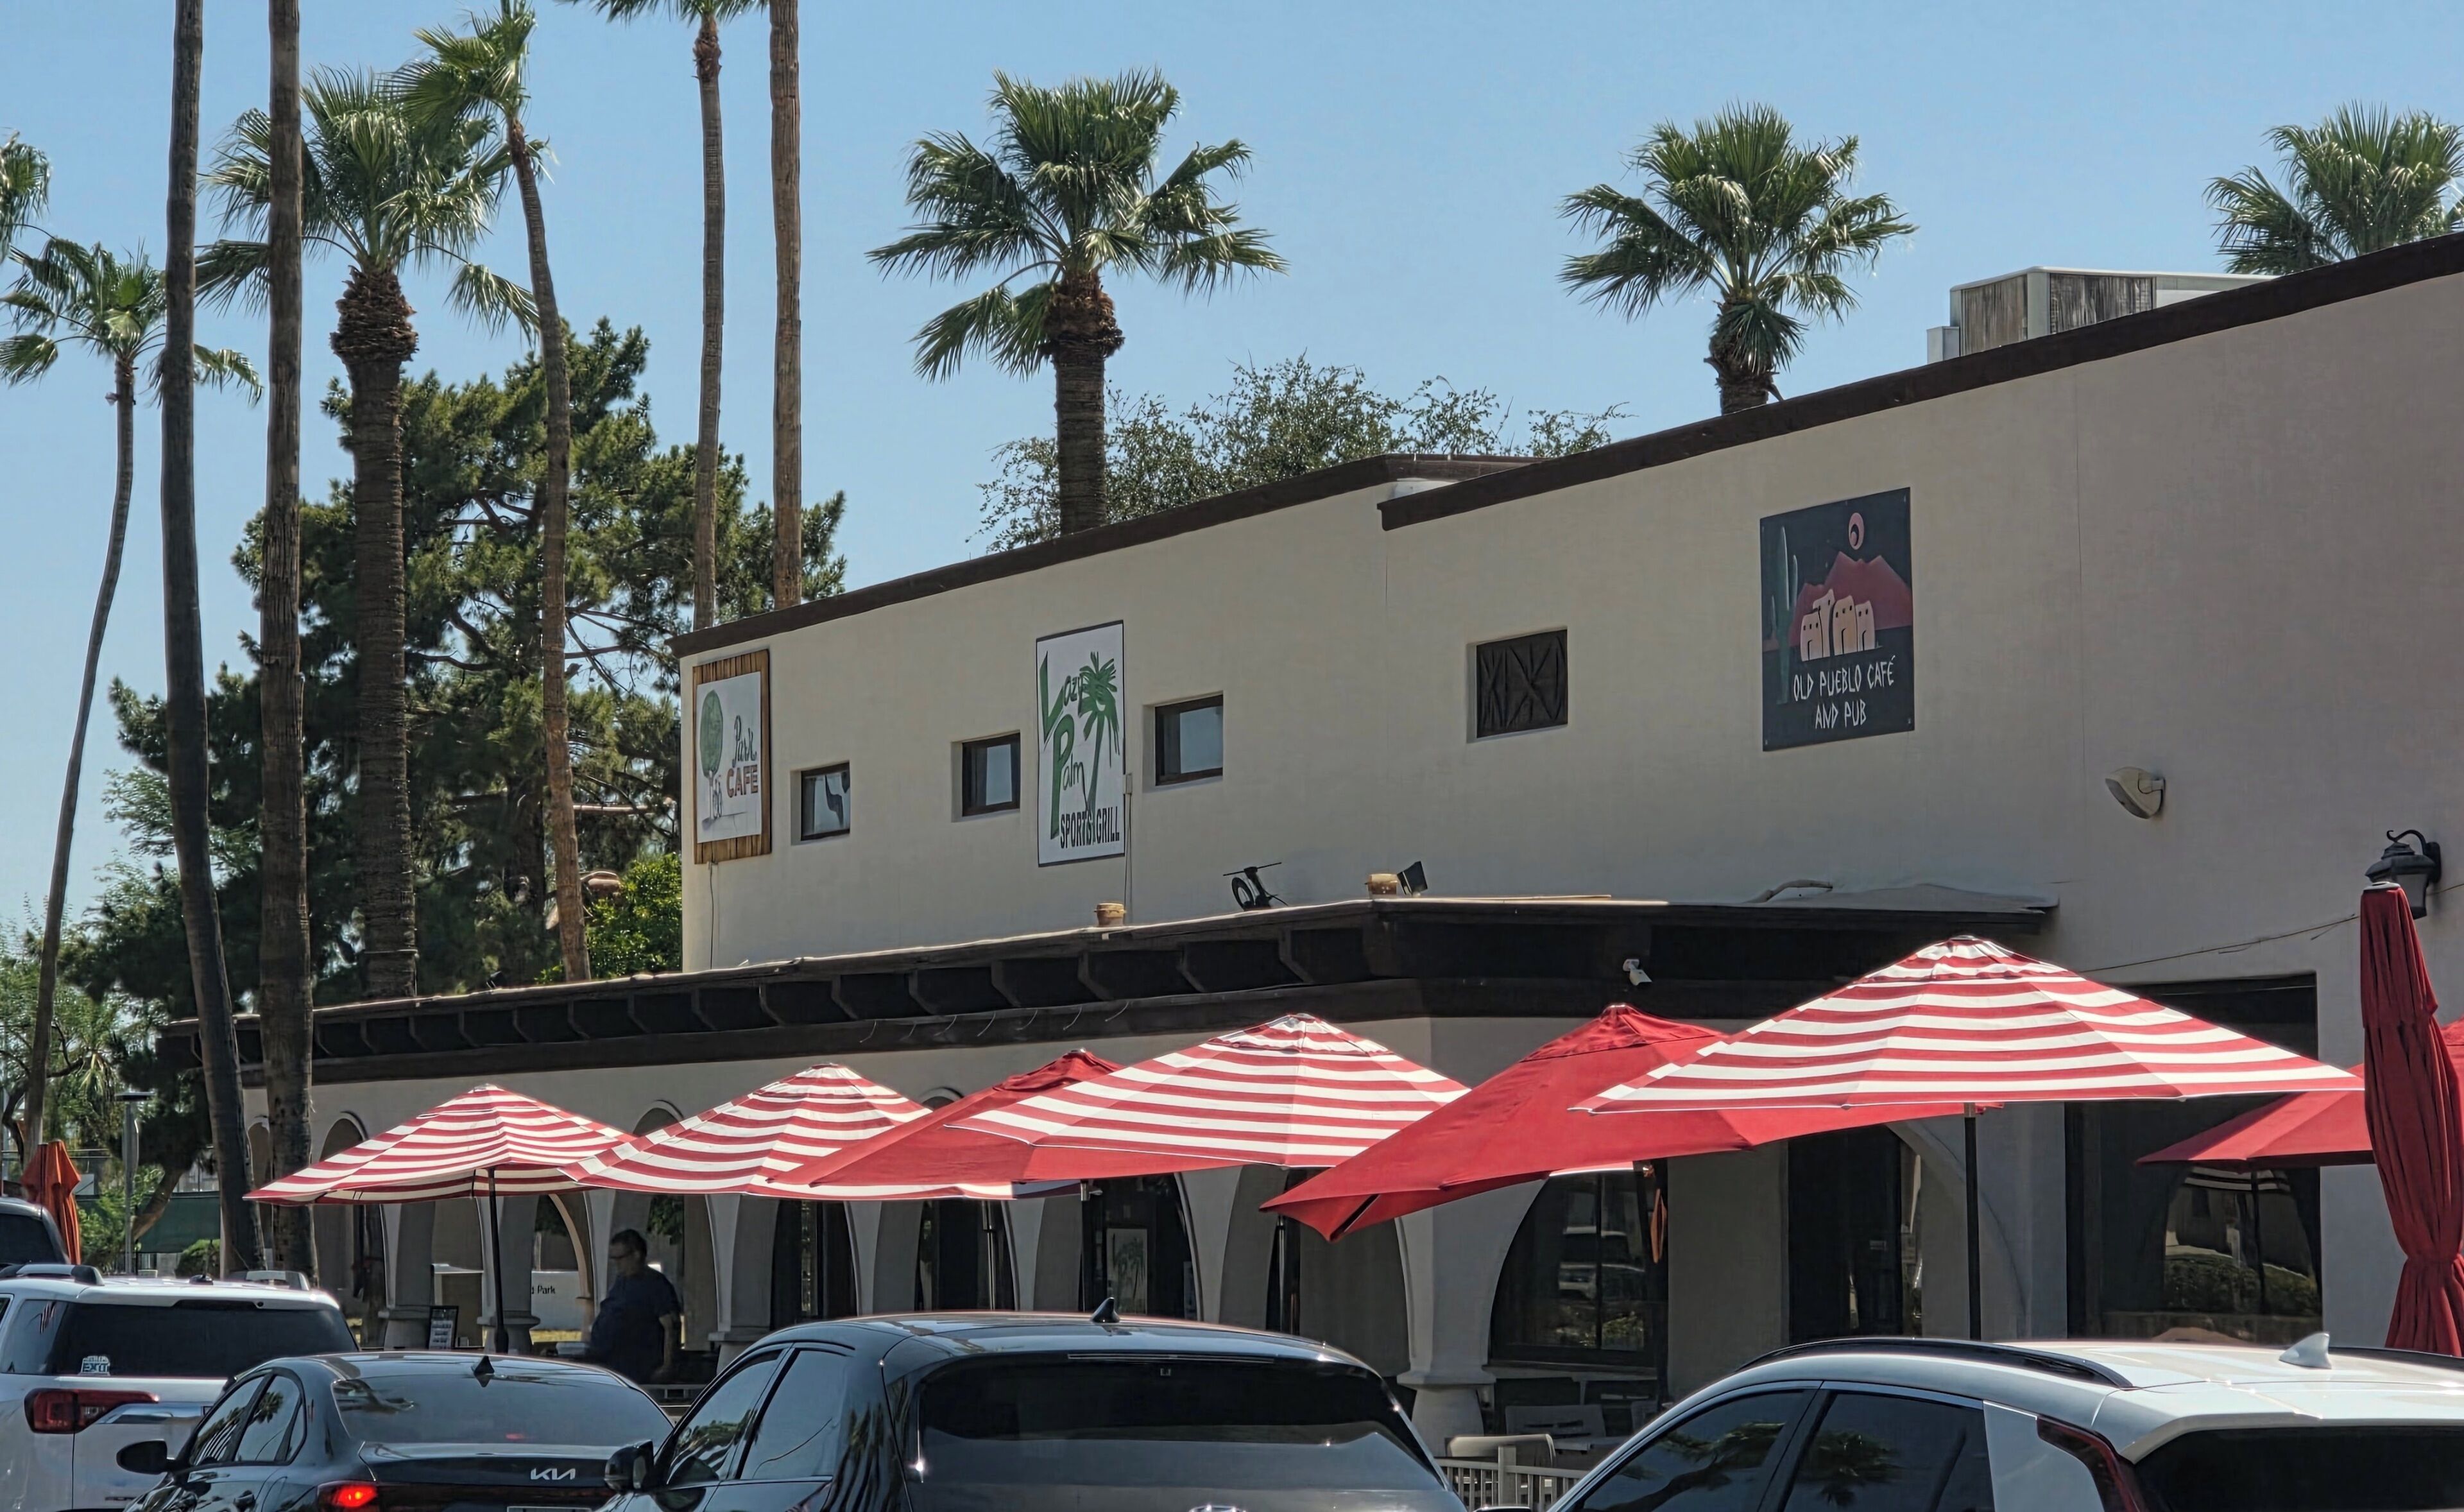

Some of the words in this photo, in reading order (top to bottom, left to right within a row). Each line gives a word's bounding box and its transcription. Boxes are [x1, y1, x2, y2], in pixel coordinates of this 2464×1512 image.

[1040, 651, 1085, 746] Lazy
[1793, 673, 1814, 702] OLD
[1819, 664, 1862, 697] PUEBLO
[1867, 655, 1896, 690] CAFÉ
[1815, 703, 1839, 730] AND
[1844, 698, 1867, 728] PUB
[732, 715, 757, 768] Park
[726, 764, 759, 798] CAFE
[1050, 713, 1088, 839] Palm
[1060, 810, 1093, 850] SPORTS
[1096, 806, 1120, 844] GRILL
[537, 1285, 556, 1294] Park
[530, 1468, 576, 1481] KIA
